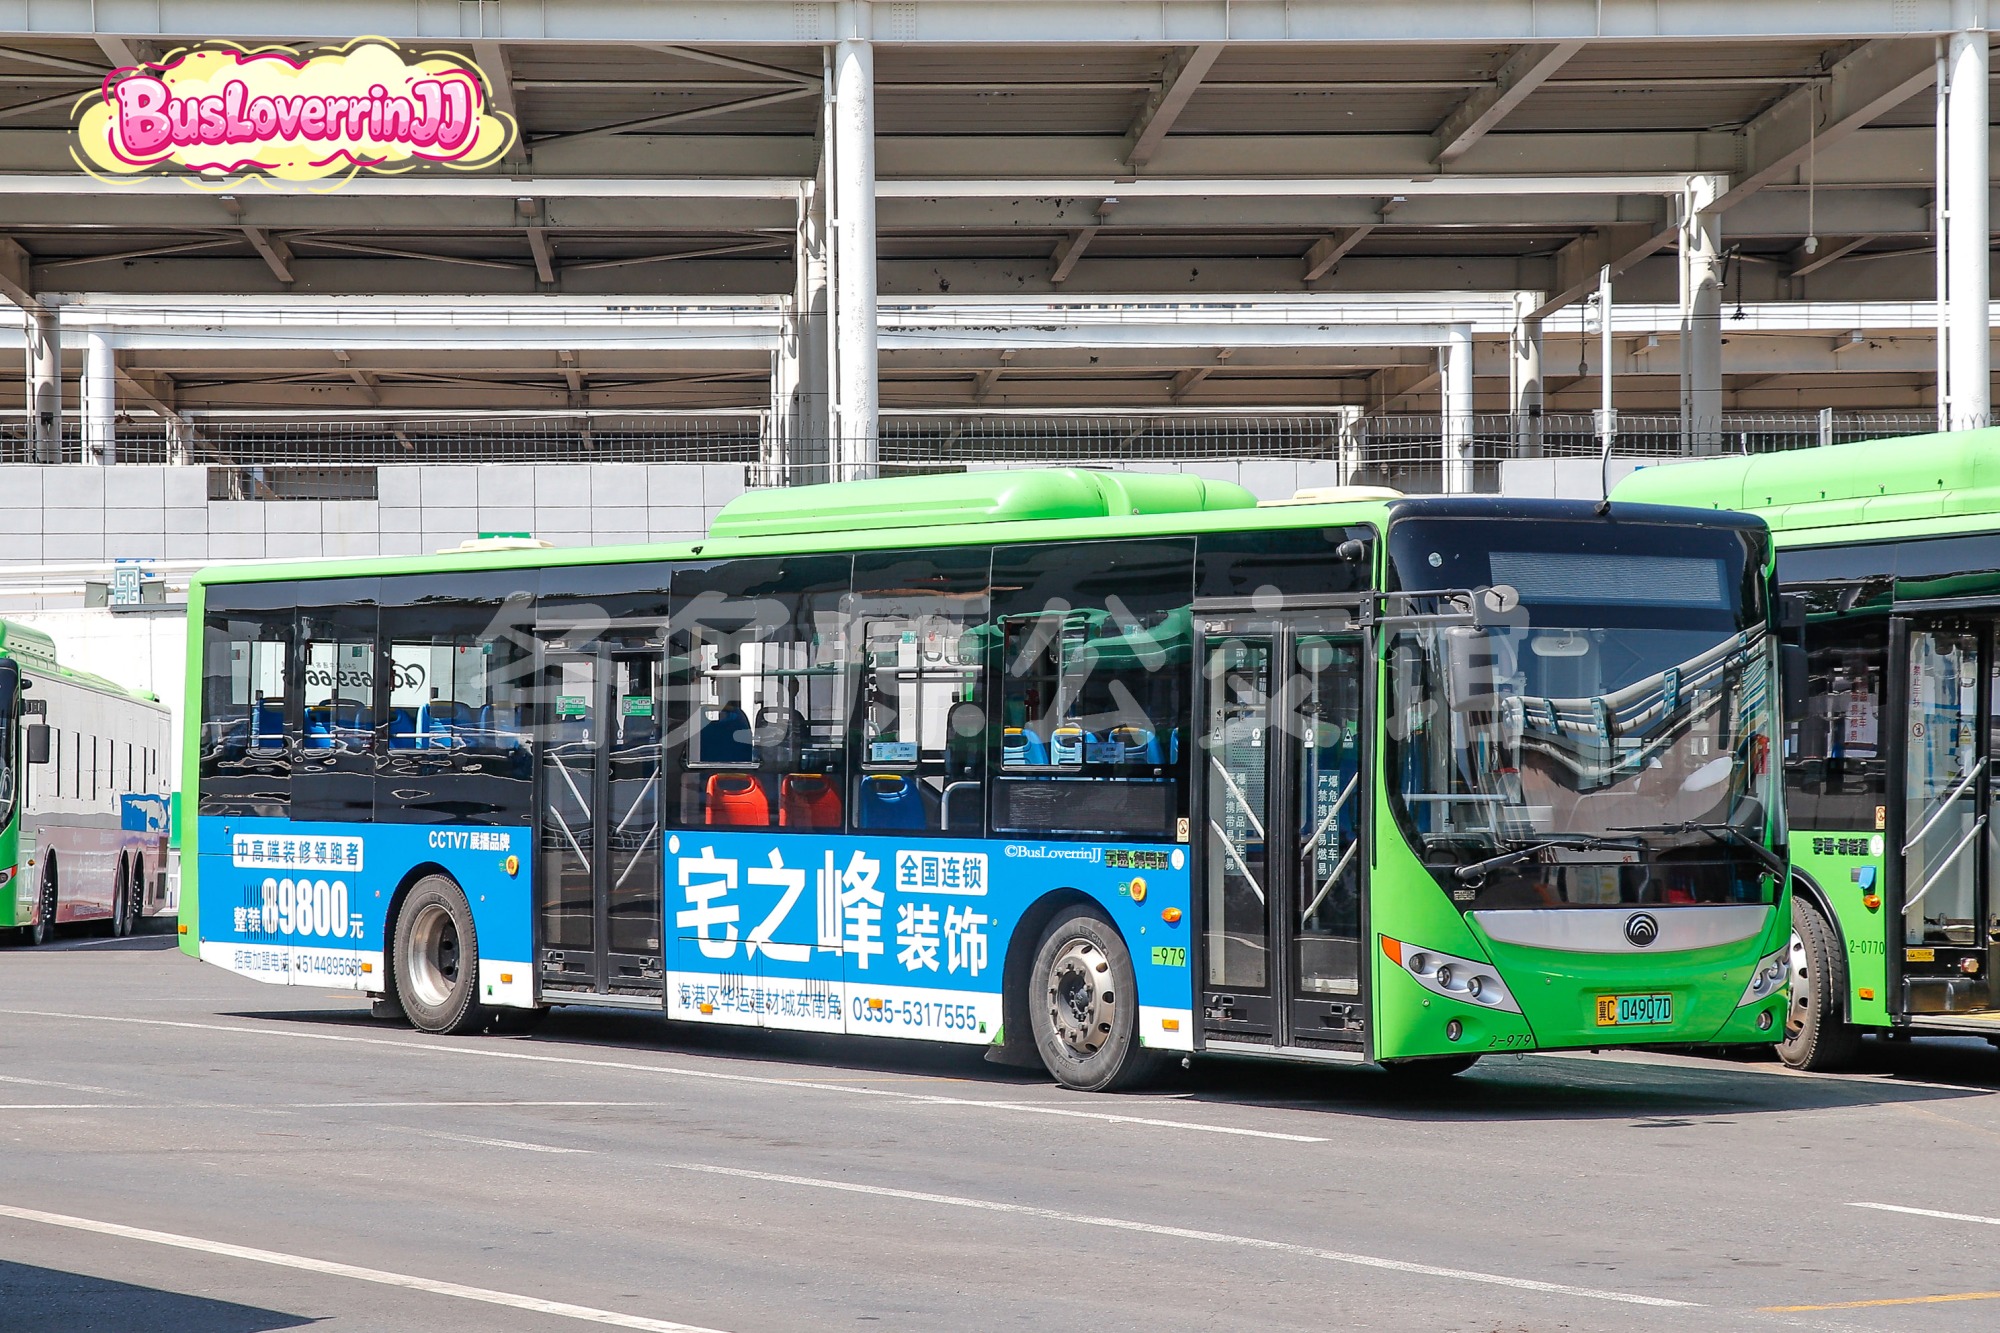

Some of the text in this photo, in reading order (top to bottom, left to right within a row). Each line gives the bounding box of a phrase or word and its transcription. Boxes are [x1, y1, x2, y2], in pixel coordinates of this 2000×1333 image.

[237, 839, 359, 866] 中高端装修领跑者
[900, 854, 983, 889] 全国连锁
[676, 845, 886, 970] 宅之峰
[896, 902, 989, 978] 装饰
[1849, 939, 1885, 956] 2-0770
[677, 982, 977, 1031] 海港区华运建材城东南角 0335-5317555
[1488, 1034, 1532, 1048] 2-979
